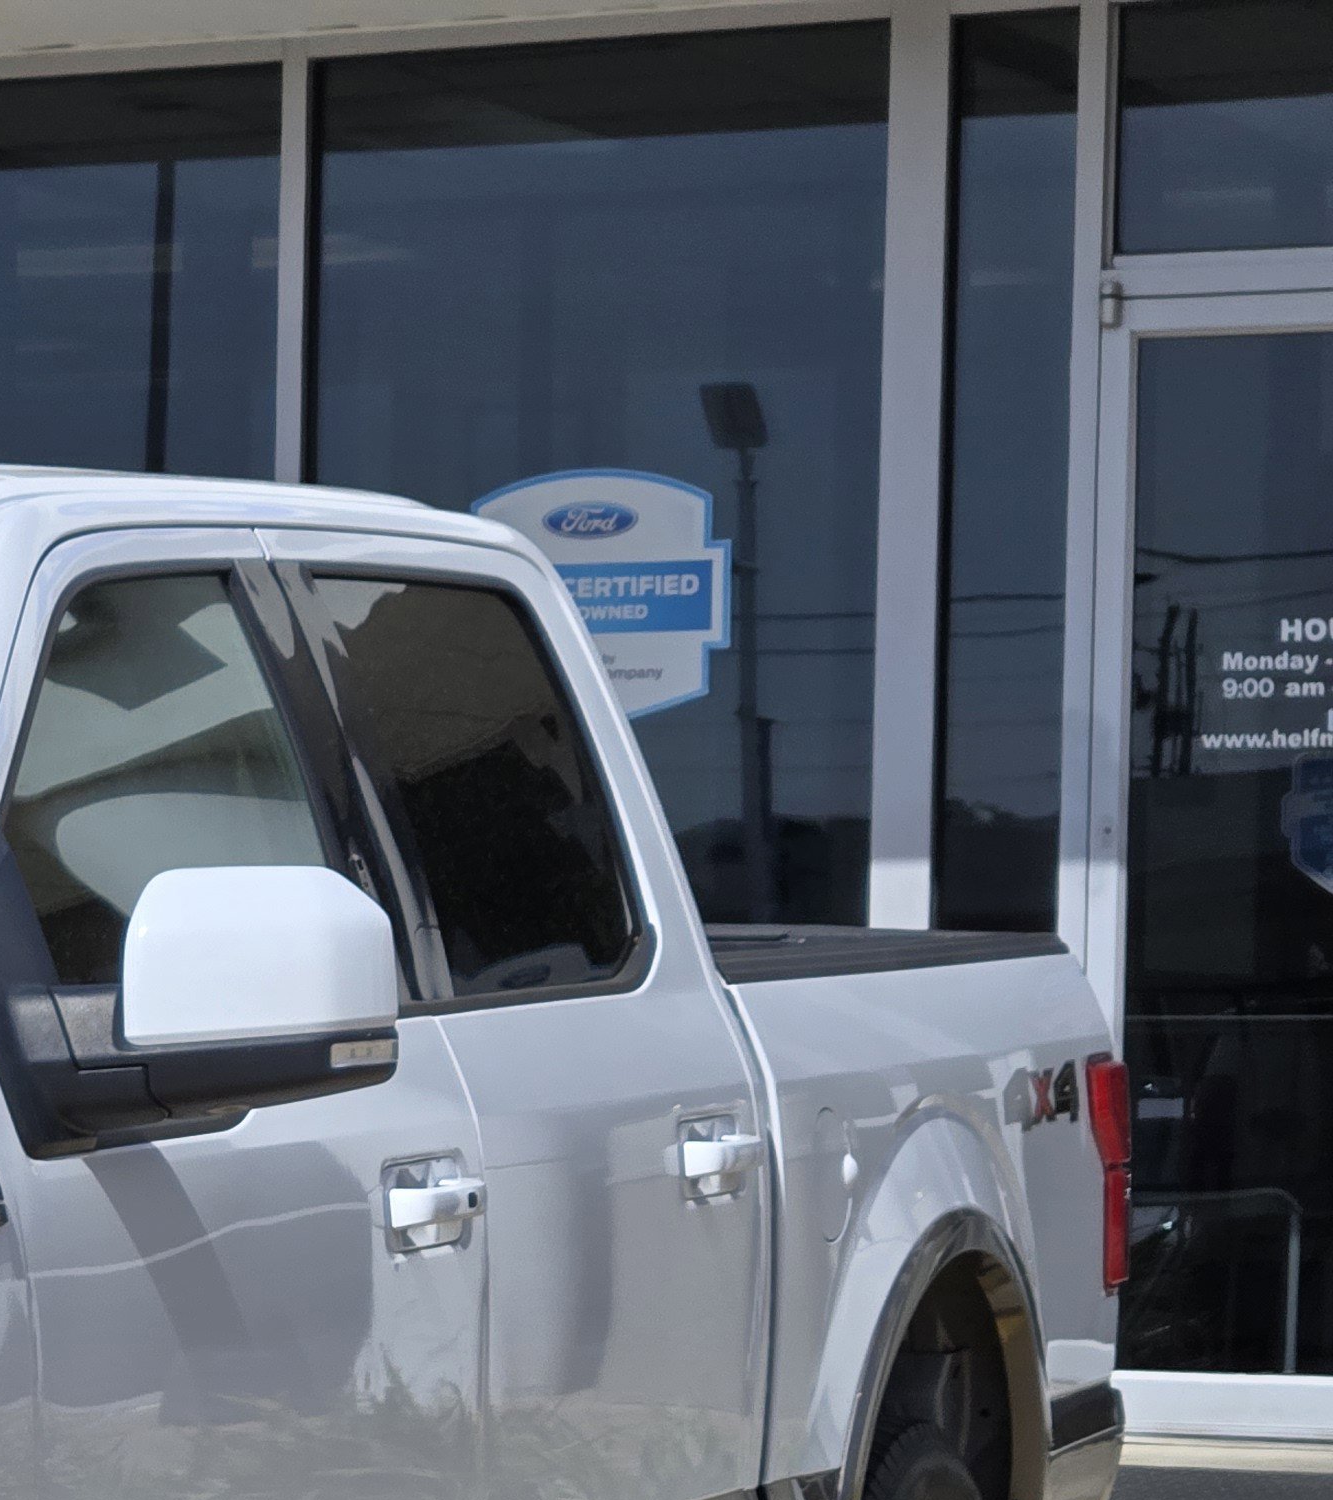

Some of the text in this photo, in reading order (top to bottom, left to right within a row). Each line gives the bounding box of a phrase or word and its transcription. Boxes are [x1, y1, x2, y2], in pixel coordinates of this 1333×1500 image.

[561, 507, 618, 533] Ford
[1279, 618, 1333, 642] HO
[1222, 651, 1319, 675] Monday
[1222, 677, 1325, 699] 9:00 am
